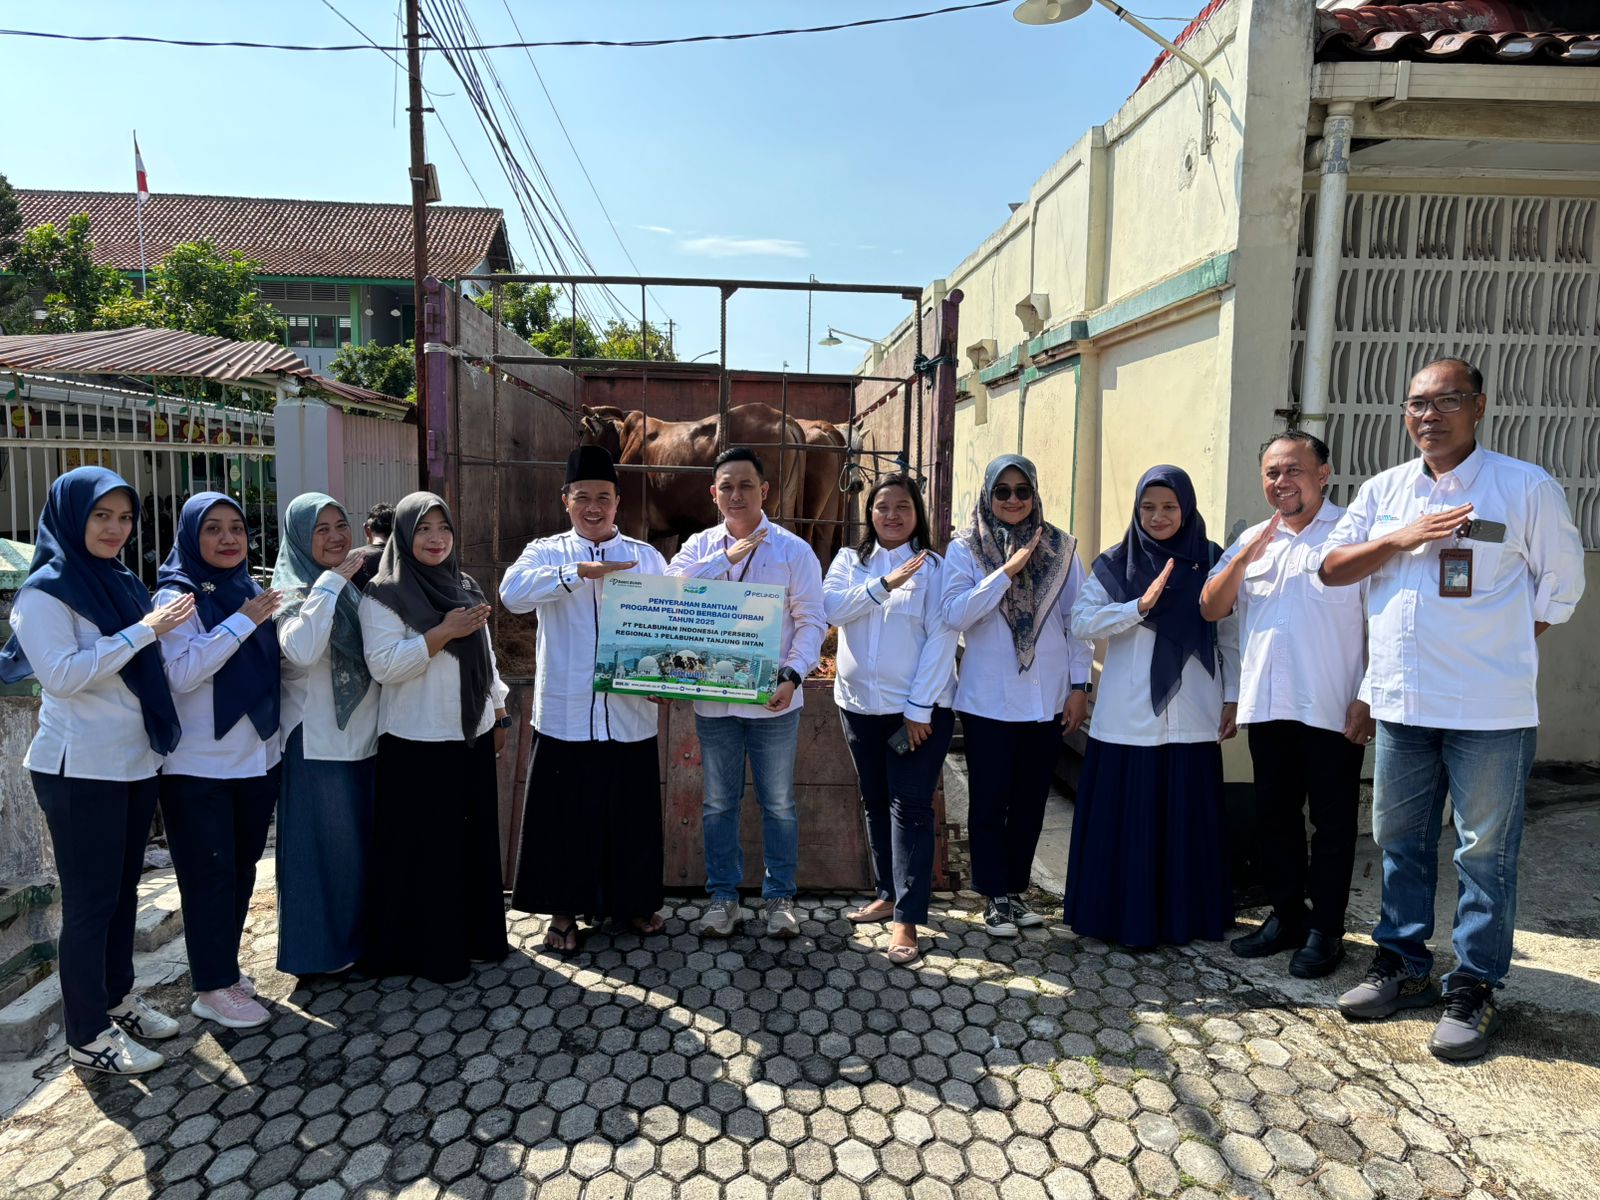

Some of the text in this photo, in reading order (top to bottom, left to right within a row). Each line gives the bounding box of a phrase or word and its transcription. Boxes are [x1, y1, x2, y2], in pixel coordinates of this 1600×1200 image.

[620, 603, 764, 621] PROGRAM PELINDO BERBAGI QURBAN
[648, 597, 738, 611] PENYERAHAN BANTUAN
[668, 615, 694, 623] TAHUN
[615, 629, 652, 637] REGIONAL
[660, 633, 704, 642] PELABUHAN
[706, 636, 740, 645] TANJUNG
[633, 622, 678, 631] PELABUHAN
[679, 626, 719, 635] INDONESIA
[720, 630, 759, 639] (PERSERO)
